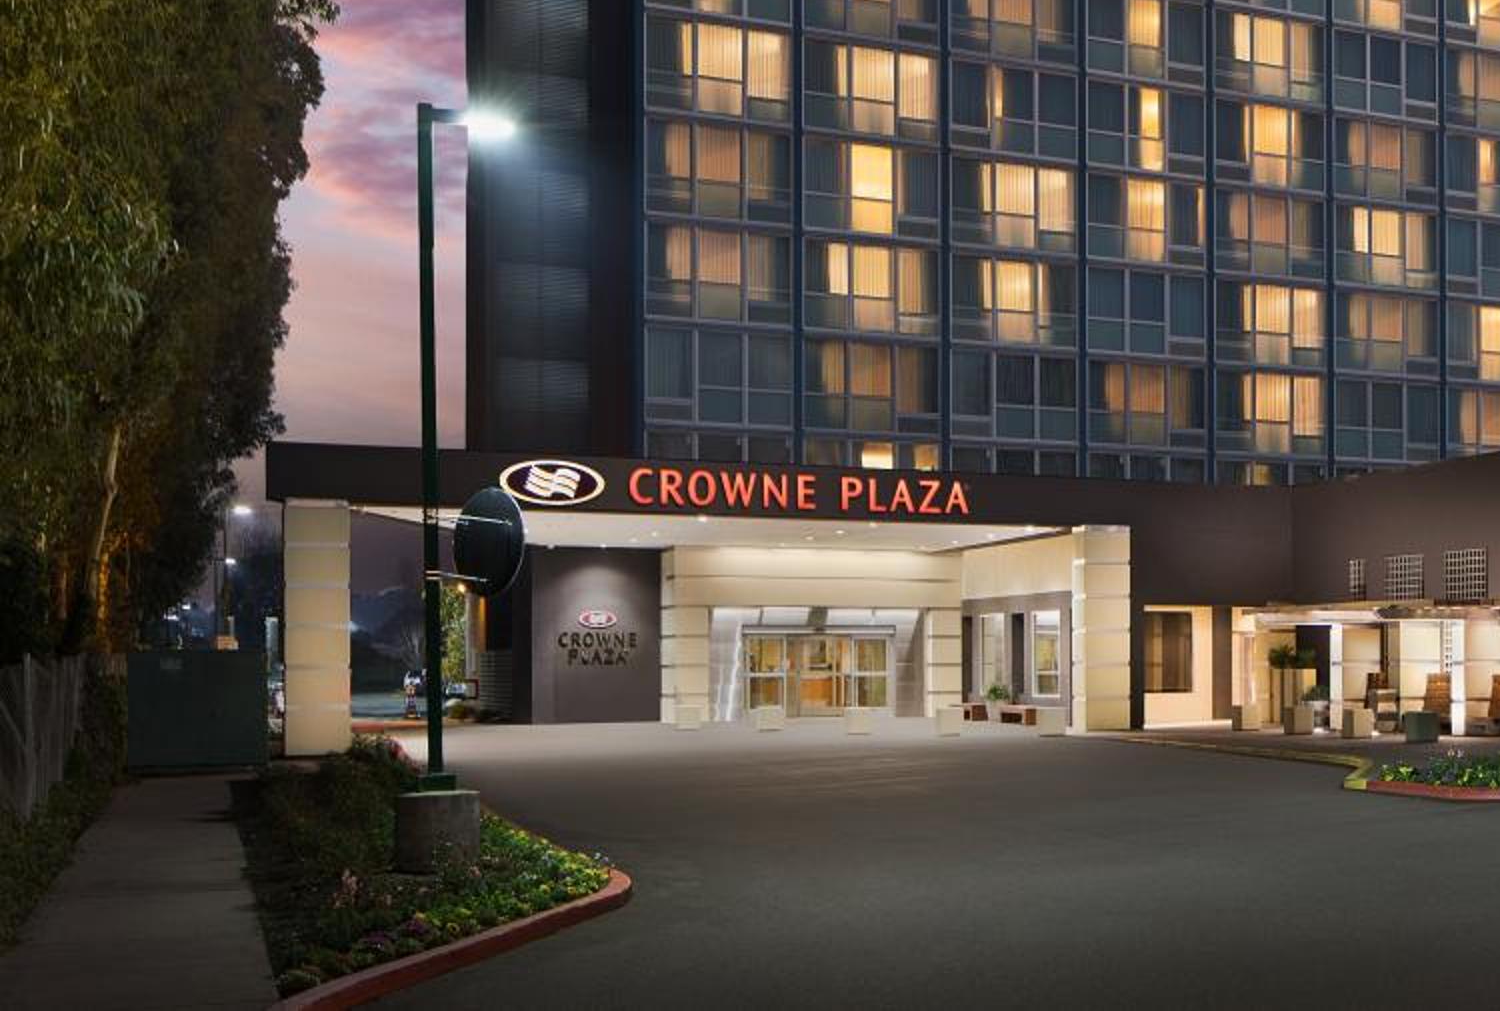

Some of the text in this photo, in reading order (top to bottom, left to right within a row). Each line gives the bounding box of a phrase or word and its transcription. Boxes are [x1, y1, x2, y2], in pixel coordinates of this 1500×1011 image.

[628, 468, 971, 515] CROWNE PLAZA
[558, 632, 637, 648] CROWNE
[568, 649, 628, 665] PLAZA
